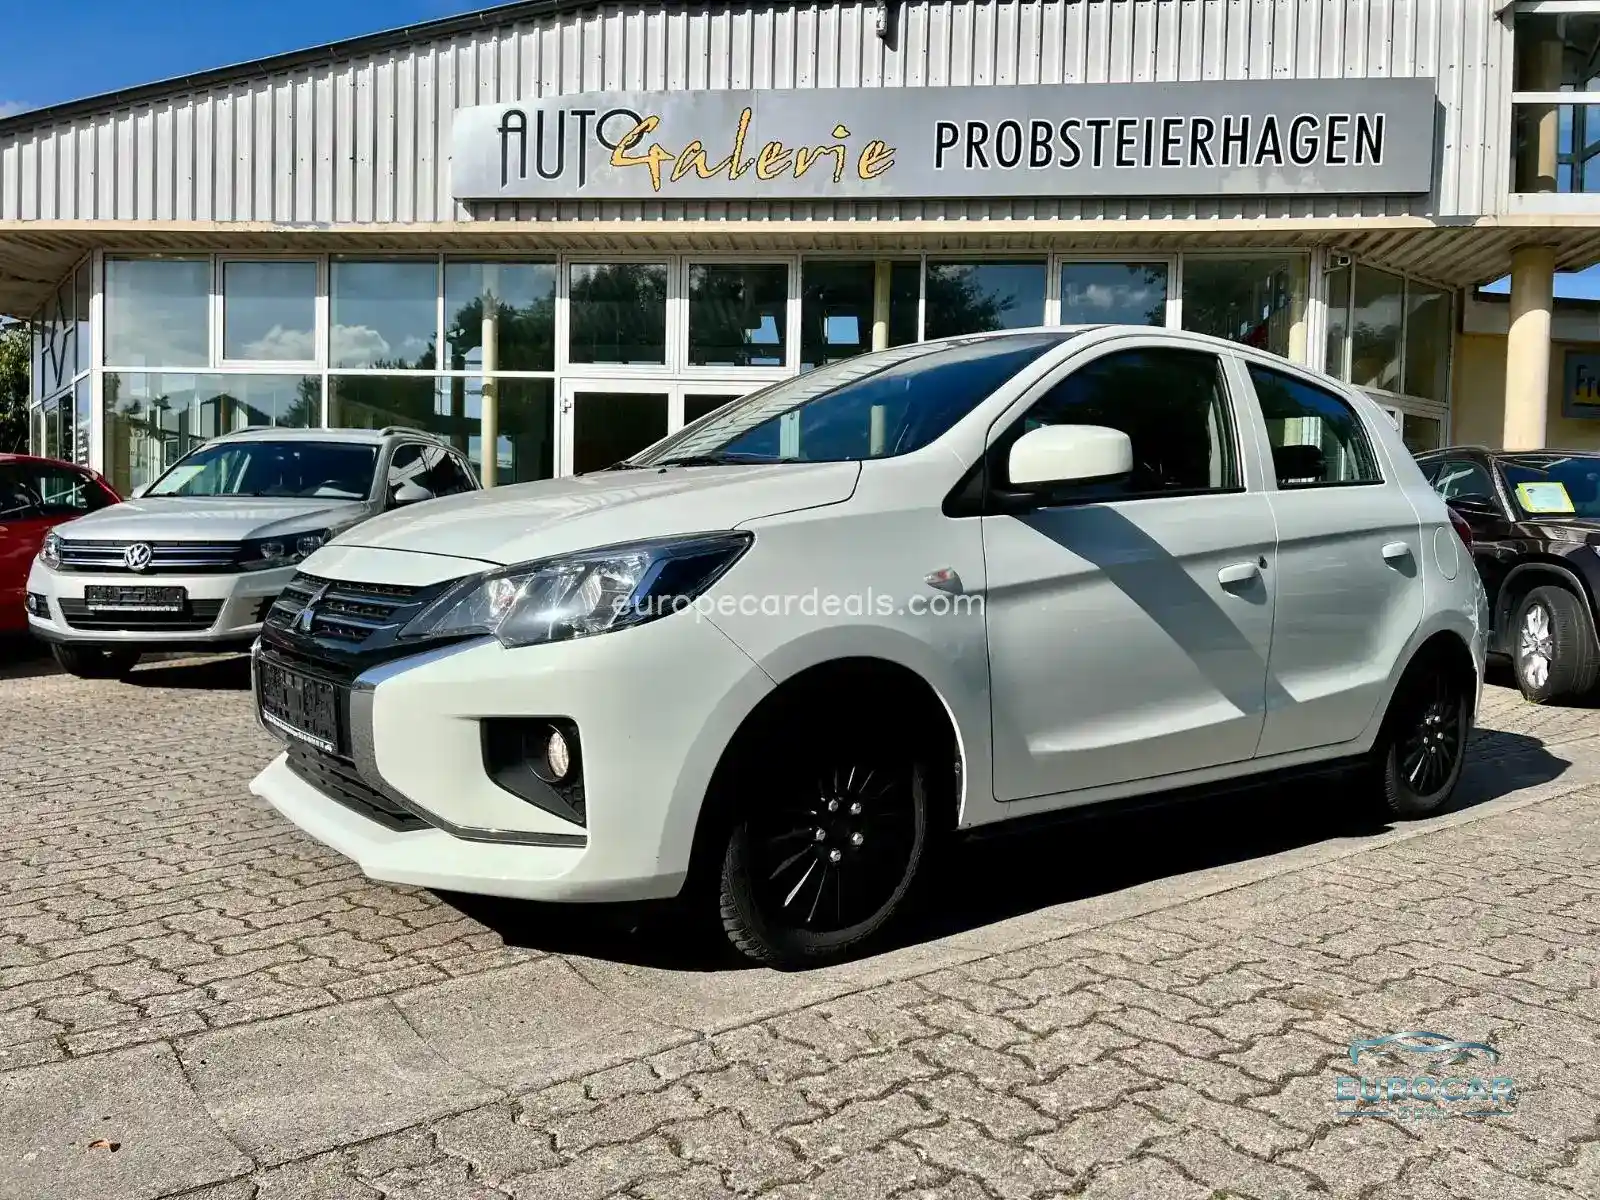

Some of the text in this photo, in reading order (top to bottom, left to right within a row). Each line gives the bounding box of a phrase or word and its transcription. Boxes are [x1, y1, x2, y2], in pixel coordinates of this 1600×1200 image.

[497, 107, 1386, 192] AUTO Galerie PROBSTEIERHAGEN
